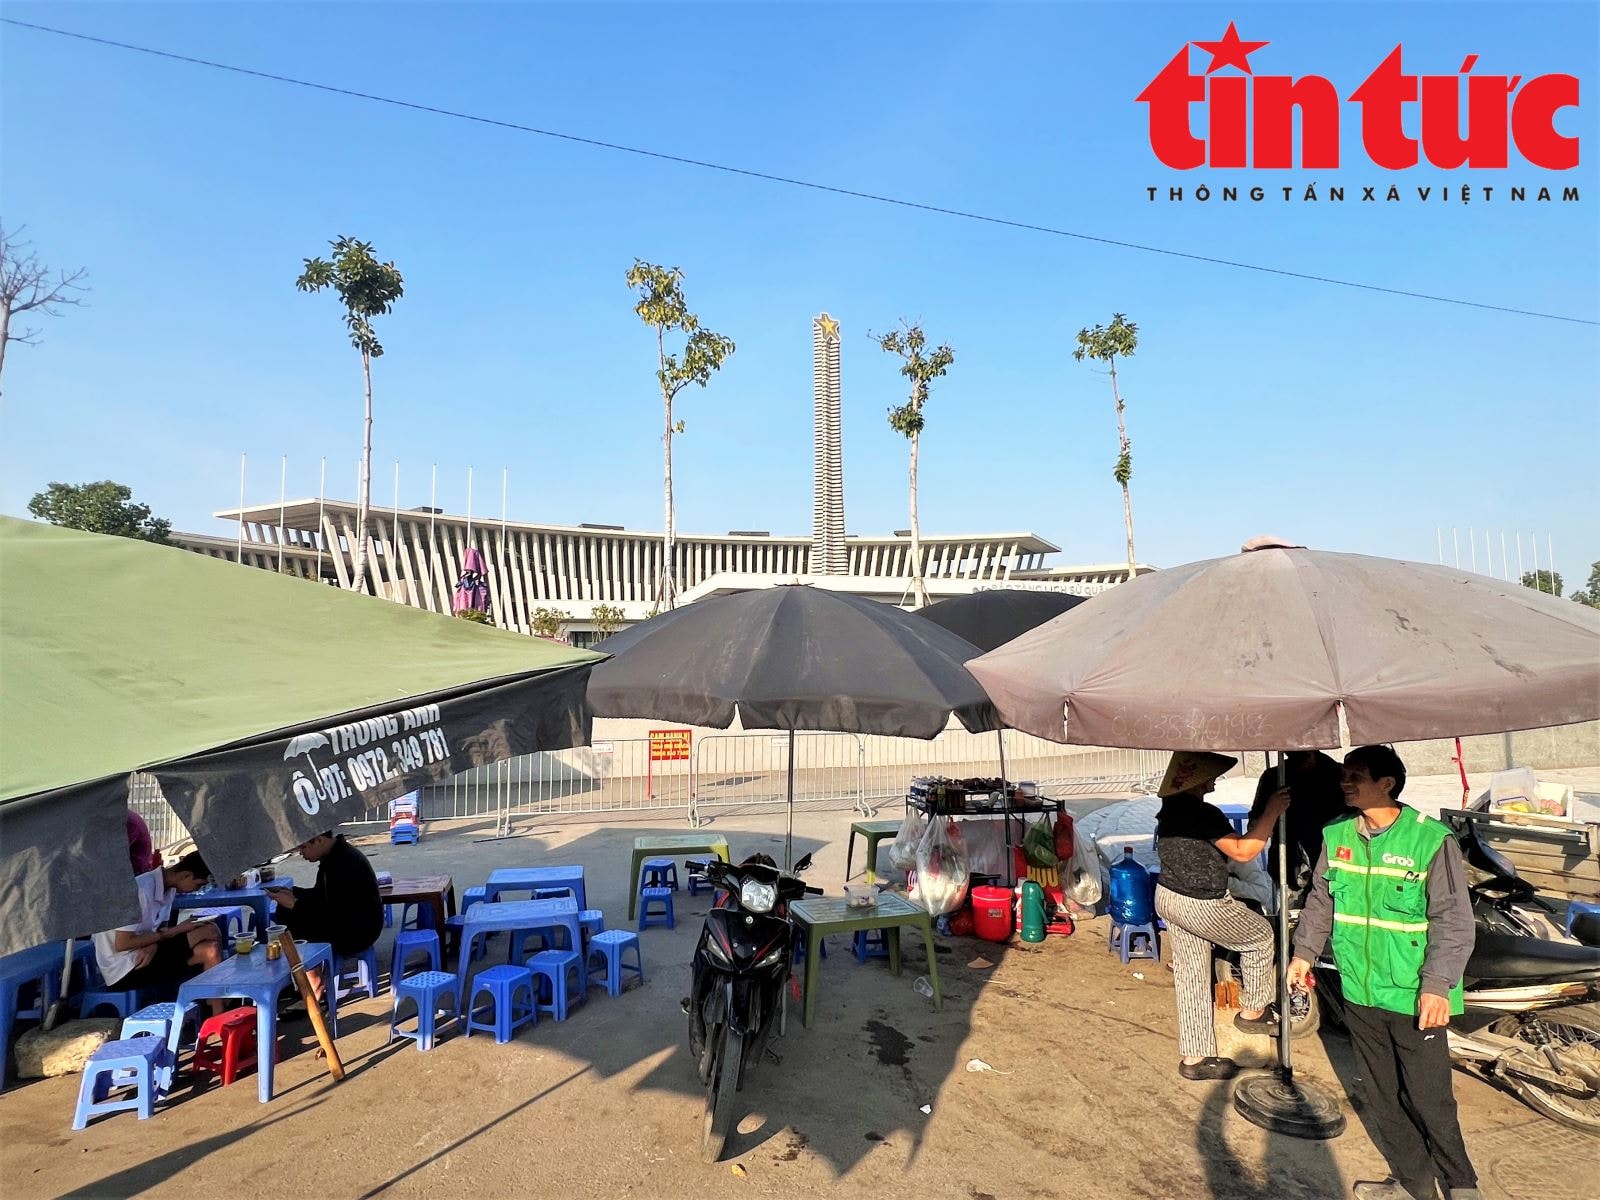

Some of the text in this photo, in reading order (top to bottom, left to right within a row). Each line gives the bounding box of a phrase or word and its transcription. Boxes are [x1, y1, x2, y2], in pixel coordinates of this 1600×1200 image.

[325, 704, 441, 755] TRUNG ANH
[292, 770, 320, 815] Ô
[420, 728, 450, 764] 781
[1382, 853, 1415, 868] Grab
